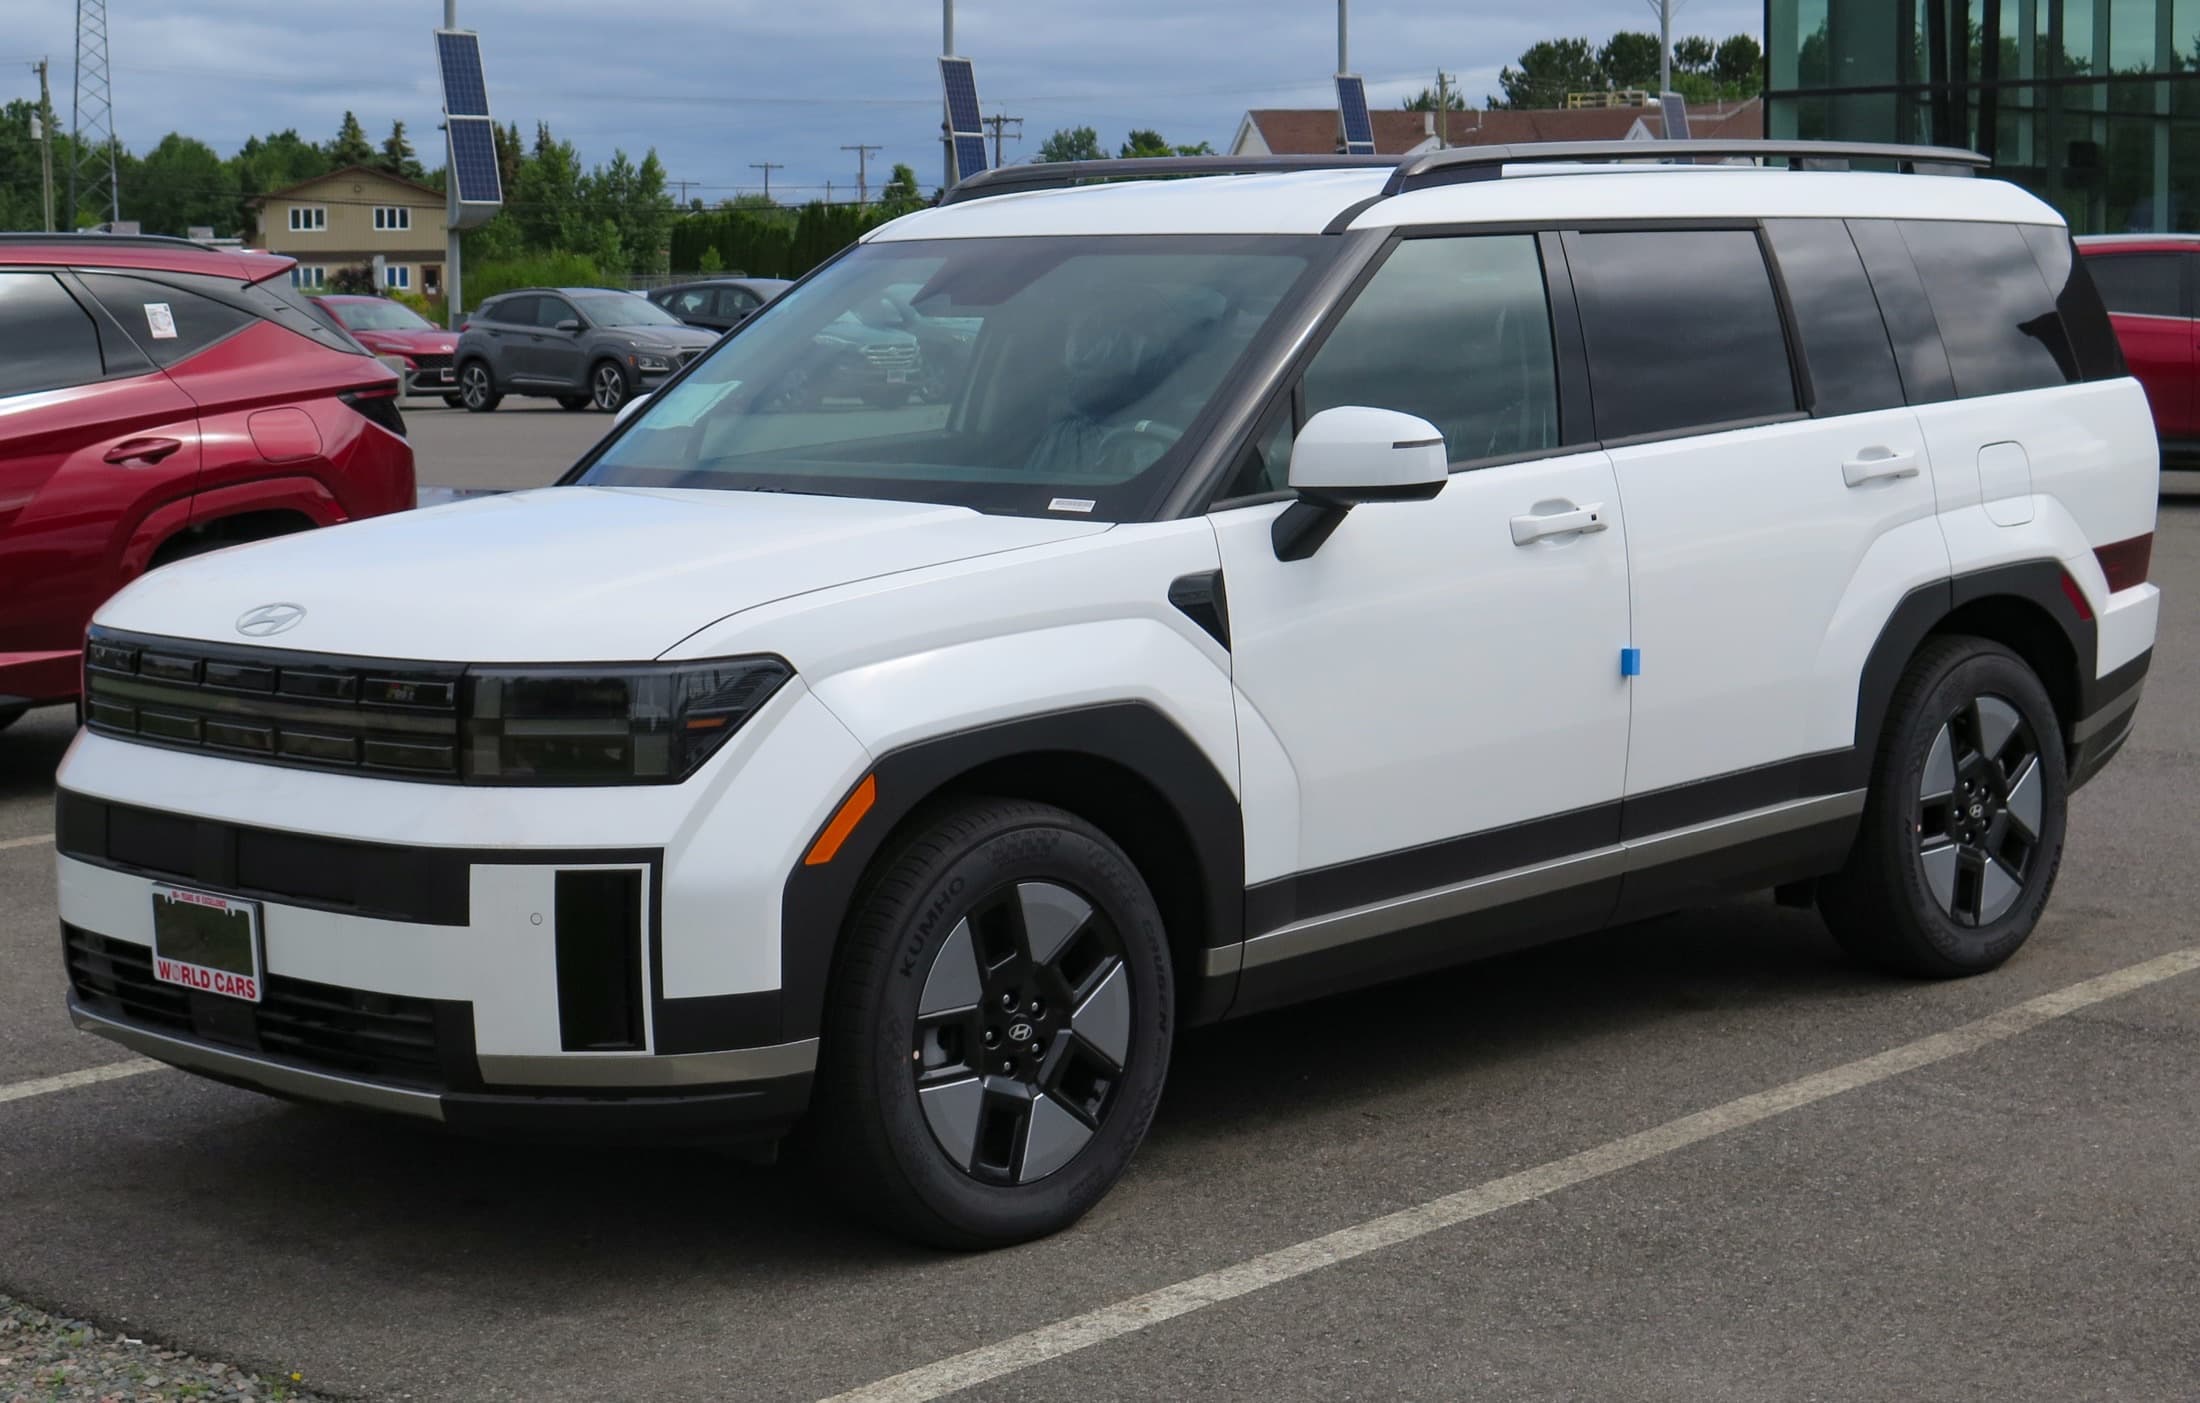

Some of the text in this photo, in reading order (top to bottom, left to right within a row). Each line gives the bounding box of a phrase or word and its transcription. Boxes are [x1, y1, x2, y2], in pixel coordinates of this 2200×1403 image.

[899, 877, 965, 977] KUMHO
[157, 960, 256, 999] WORLD CARS
